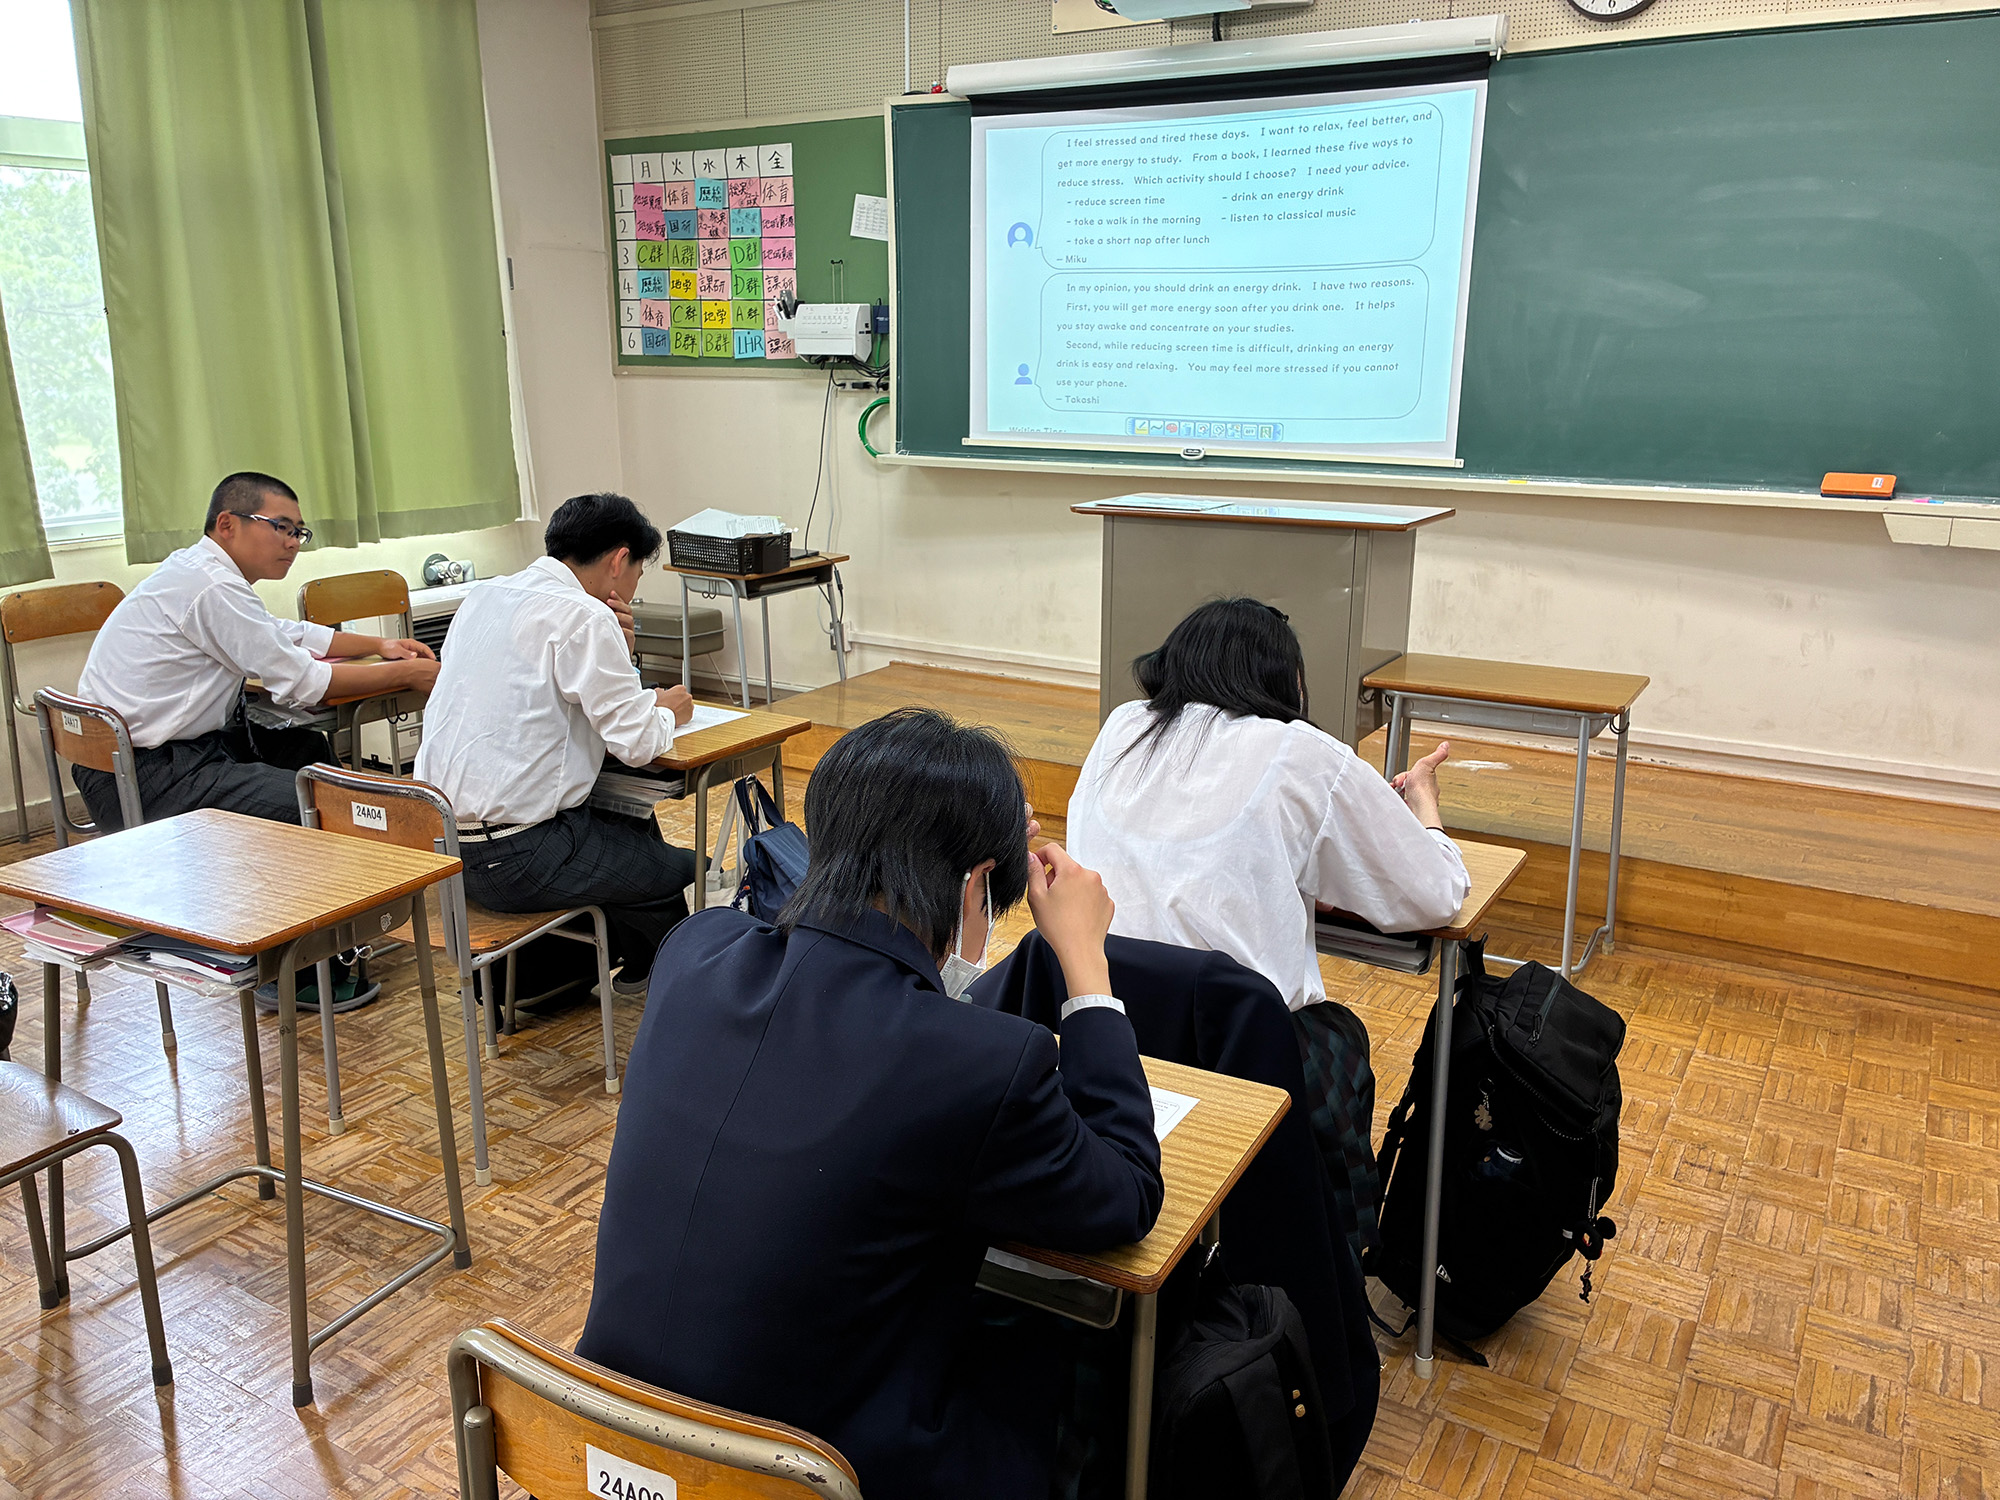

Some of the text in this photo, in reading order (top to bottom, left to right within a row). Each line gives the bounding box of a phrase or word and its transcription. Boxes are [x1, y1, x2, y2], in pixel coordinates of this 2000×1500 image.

[1067, 110, 1432, 148] I feel stressed and tired these days. I want to relax, feel better, and
[1057, 160, 1073, 170] get
[1101, 158, 1135, 167] energy
[1137, 157, 1148, 165] to
[1151, 155, 1182, 165] study.
[1192, 153, 1218, 162] From
[1221, 153, 1227, 161] a
[1231, 149, 1259, 160] book,
[1263, 148, 1268, 158] I
[1271, 145, 1311, 157] learned
[1315, 144, 1345, 153] these
[1348, 140, 1369, 150] five
[1372, 139, 1398, 149] ways
[1402, 137, 1413, 145] to
[641, 160, 651, 178] 月
[671, 158, 684, 176] 火
[703, 158, 717, 173] 水
[736, 154, 751, 171] 木
[1057, 159, 1409, 187] reduce stress. Which activity should I choose? I need your advice.
[619, 189, 625, 208] 1
[667, 186, 690, 206] 体育
[762, 180, 790, 203] 体育
[1075, 195, 1165, 206] reduce screen time
[1231, 192, 1257, 202] drink
[1277, 190, 1314, 200] energy
[1317, 186, 1344, 197] drink
[1074, 217, 1095, 226] take
[1106, 216, 1128, 225] walk
[1130, 216, 1139, 225] in
[1142, 216, 1159, 224] the
[1161, 215, 1201, 226] morning
[1230, 207, 1356, 222] listen to classical music
[619, 218, 629, 234] 2
[1074, 236, 1095, 245] take
[1106, 236, 1131, 245] short
[1134, 237, 1152, 246] nap
[1154, 235, 1181, 244] after
[1183, 235, 1210, 244] lunch
[622, 247, 630, 265] 3
[637, 244, 664, 264] C群
[672, 244, 695, 267] A群
[701, 244, 728, 266] 課研
[733, 242, 758, 265] D群
[1065, 255, 1087, 263] Miku
[623, 278, 634, 294] 4
[1067, 283, 1076, 292] In
[1078, 285, 1092, 294] my
[1093, 283, 1131, 294] opinion,
[1133, 285, 1151, 294] you
[1154, 283, 1186, 292] should
[1188, 283, 1214, 292] drink
[1233, 285, 1269, 294] energy
[1271, 282, 1301, 291] drink.
[1312, 281, 1317, 291] I
[1320, 281, 1345, 290] have
[1349, 281, 1367, 289] two
[1371, 278, 1415, 288] reasons.
[626, 306, 634, 322] 5
[1066, 302, 1091, 312] First,
[1093, 304, 1110, 313] you
[1112, 302, 1128, 311] will
[1131, 304, 1147, 314] get
[1177, 305, 1212, 315] energy
[1214, 305, 1238, 313] soon
[1241, 303, 1268, 312] after
[1270, 305, 1289, 314] you
[1292, 302, 1319, 312] drink
[1355, 301, 1364, 310] It
[1368, 300, 1395, 311] helps
[1057, 323, 1073, 332] you
[1075, 323, 1095, 332] stay
[1097, 322, 1127, 330] awake
[1129, 322, 1147, 331] and
[1150, 324, 1210, 332] concentrate
[1227, 325, 1251, 334] your
[1253, 323, 1294, 333] studies.
[628, 332, 636, 349] 6
[705, 332, 730, 353] B群
[738, 335, 764, 355] LHR
[1066, 340, 1101, 350] Second,
[1104, 341, 1128, 350] while
[1131, 342, 1172, 353] reducing
[1211, 344, 1233, 352] time
[1236, 343, 1245, 353] is
[1248, 343, 1293, 353] difficult,
[1297, 343, 1339, 355] drinking
[1358, 344, 1394, 353] energy
[1081, 359, 1089, 368] is
[1092, 362, 1114, 370] easy
[1116, 361, 1133, 369] and
[1136, 361, 1178, 373] relaxing.
[1188, 362, 1207, 372] You
[1209, 365, 1230, 374] may
[1233, 363, 1252, 372] feel
[1284, 364, 1328, 373] stressed
[1332, 363, 1340, 373] if
[1342, 365, 1361, 374] you
[1364, 363, 1399, 372] cannot
[1074, 380, 1094, 388] your
[1096, 379, 1127, 389] phone.
[1064, 395, 1100, 404] Takashi
[356, 805, 383, 821] 24A04
